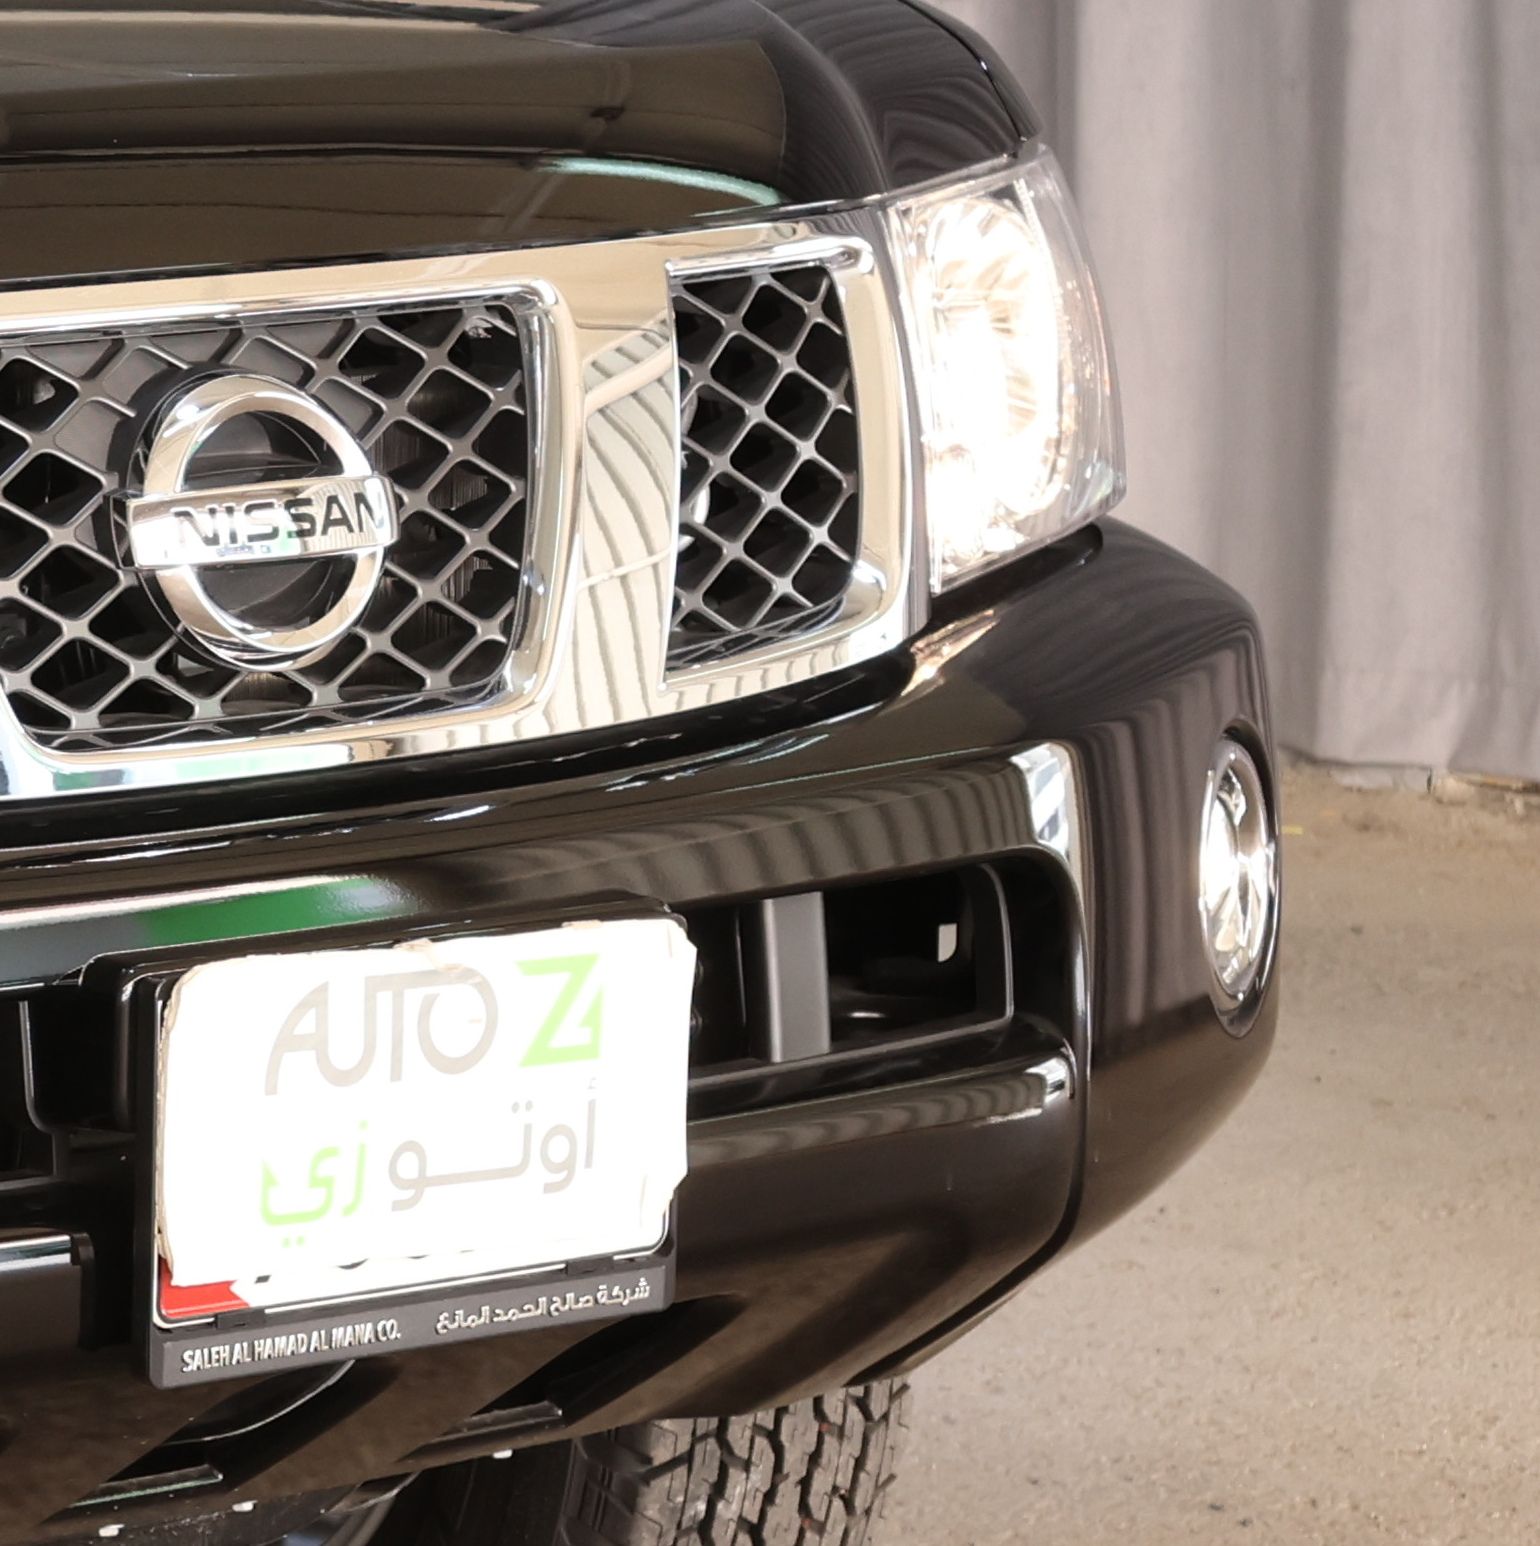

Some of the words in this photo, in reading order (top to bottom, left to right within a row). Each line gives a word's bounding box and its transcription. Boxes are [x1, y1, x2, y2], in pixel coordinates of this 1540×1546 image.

[171, 490, 386, 548] NISSAN
[264, 966, 499, 1095] AUTO
[595, 1276, 651, 1307] شركة
[181, 1344, 230, 1373] SALEH
[231, 1341, 251, 1365] AL
[253, 1332, 308, 1362] HAMAD
[309, 1329, 329, 1353] AL
[330, 1321, 375, 1349] MANA
[376, 1318, 402, 1342] CO.
